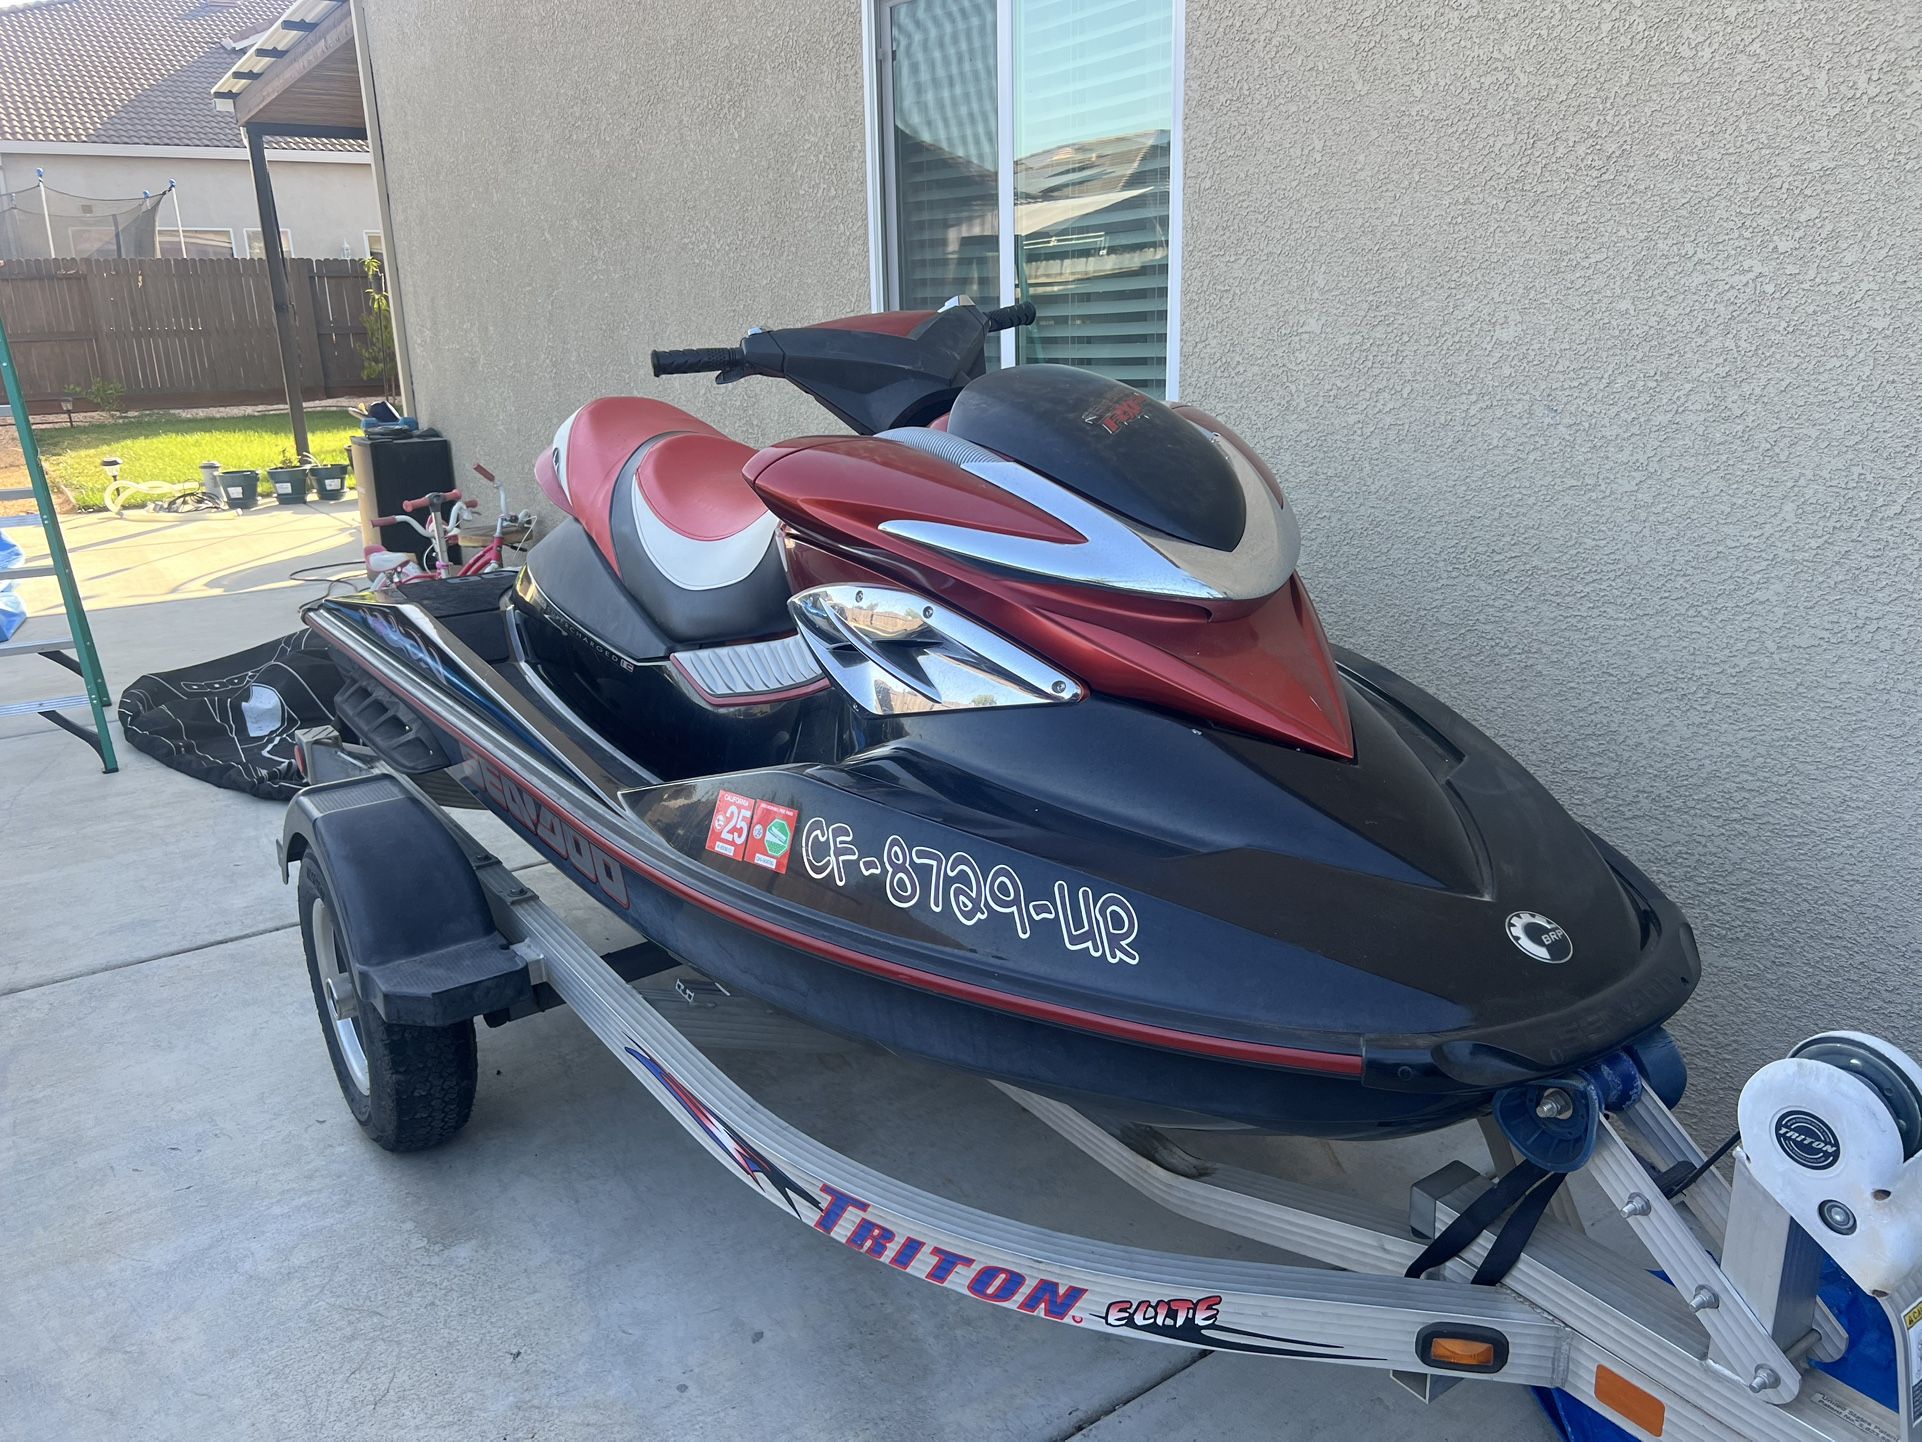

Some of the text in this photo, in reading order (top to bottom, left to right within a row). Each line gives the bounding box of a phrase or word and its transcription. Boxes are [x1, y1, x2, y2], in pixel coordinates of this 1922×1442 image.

[721, 805, 751, 845] 25
[802, 817, 1139, 965] CF-8729-UR
[1541, 929, 1563, 945] BRP
[1779, 1126, 1837, 1153] TRITON
[814, 1183, 1223, 1328] TRITON ELITE
